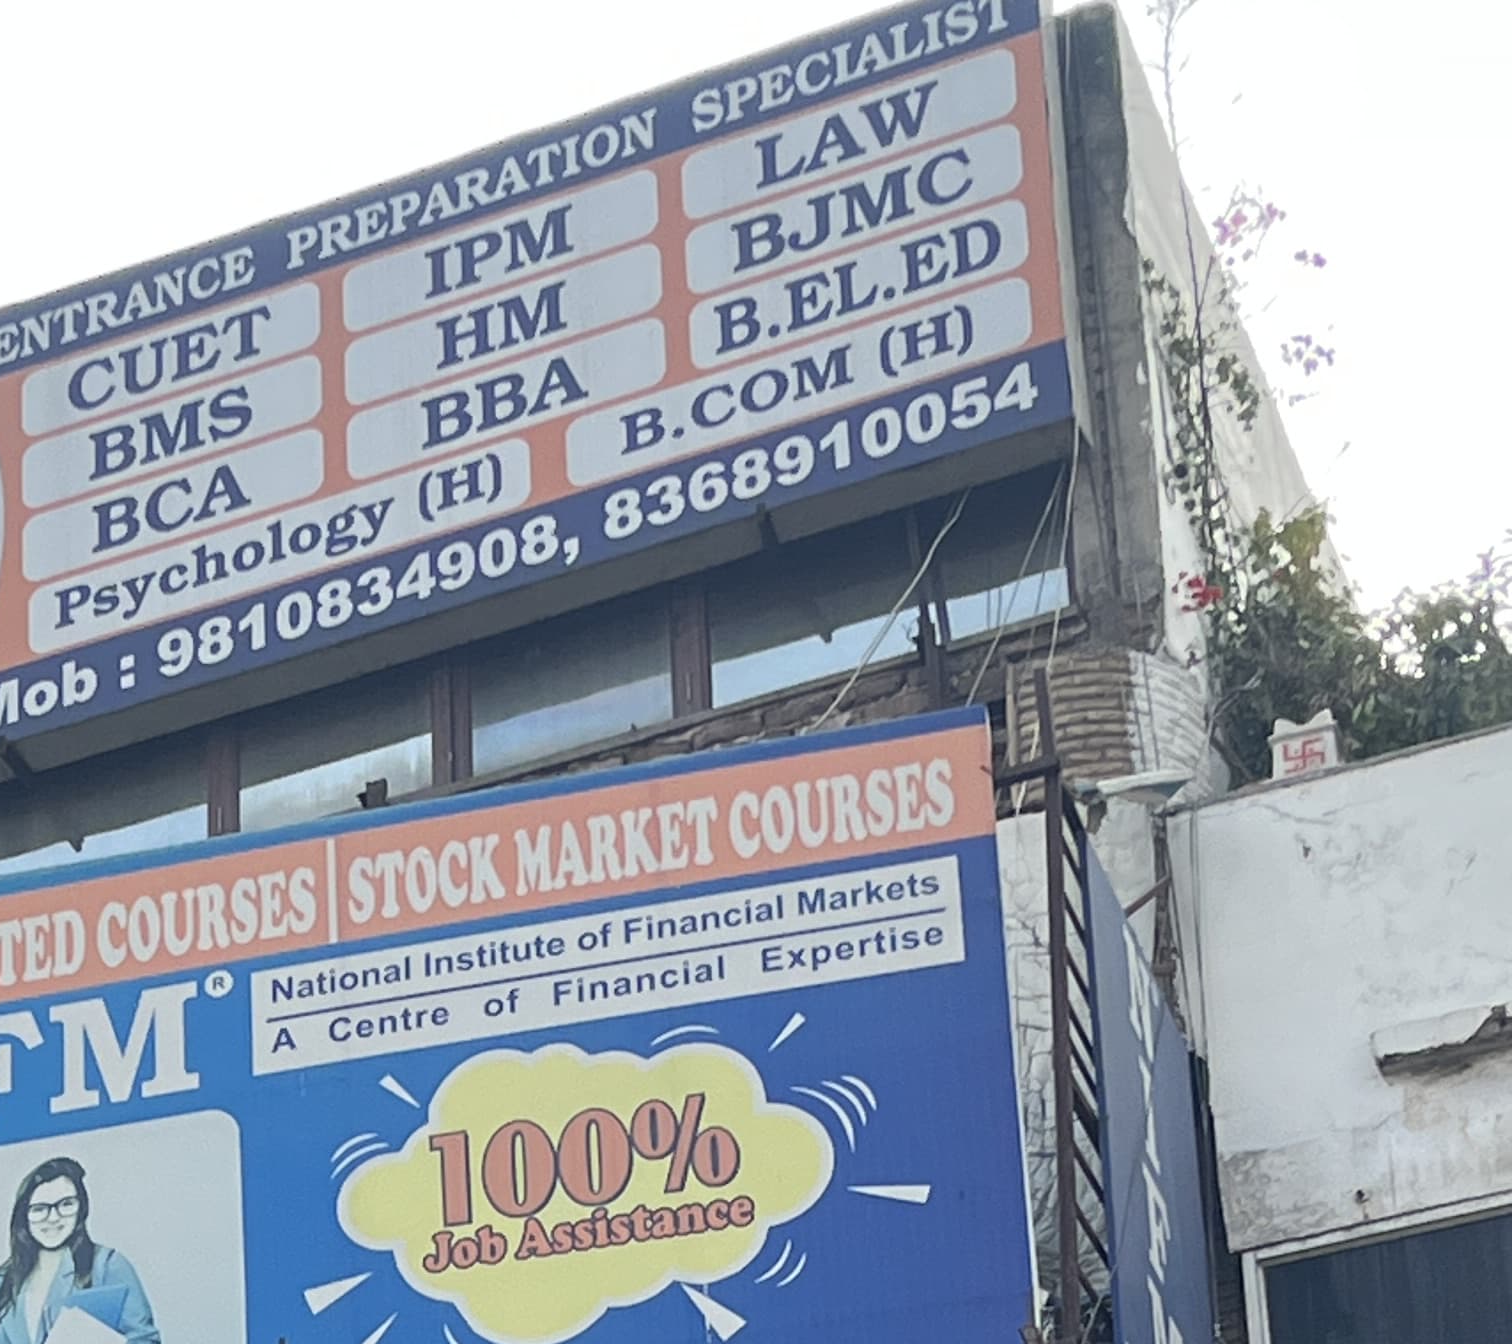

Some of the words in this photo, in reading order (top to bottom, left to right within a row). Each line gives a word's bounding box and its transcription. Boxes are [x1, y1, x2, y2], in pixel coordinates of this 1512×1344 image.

[286, 107, 657, 269] PREPARATION
[691, 0, 1009, 132] SPECIALIST
[756, 81, 939, 190] LAW
[426, 204, 574, 299] IPM
[731, 148, 974, 274] BJMC
[436, 281, 567, 370] HM
[714, 218, 1002, 356] B.EL.ED
[67, 305, 271, 411] CUET
[422, 357, 588, 450] BBA
[619, 344, 854, 456] B.COM
[879, 304, 974, 377] (H)
[89, 386, 253, 481] BMS
[55, 497, 394, 630] Psychology
[418, 454, 503, 522] (H)
[92, 464, 252, 554] BCA
[158, 515, 580, 677] 9810834908,
[604, 360, 1038, 541] 8368910054
[97, 866, 317, 967] COURSES
[348, 832, 505, 926] STOCK
[514, 798, 719, 896] MARKET
[728, 757, 955, 860] COURSES
[270, 953, 413, 1005] National
[423, 931, 566, 978] Institute
[576, 921, 612, 953] of
[623, 895, 785, 946] Financial
[796, 870, 941, 918] Markets
[270, 1027, 297, 1054] A
[328, 1001, 451, 1044] Centre
[484, 988, 520, 1019] of
[553, 954, 727, 1009] Financial
[760, 922, 945, 976] Expertise
[428, 1092, 741, 1228] 100%
[423, 1220, 507, 1274] Job
[516, 1195, 755, 1262] Assistance
